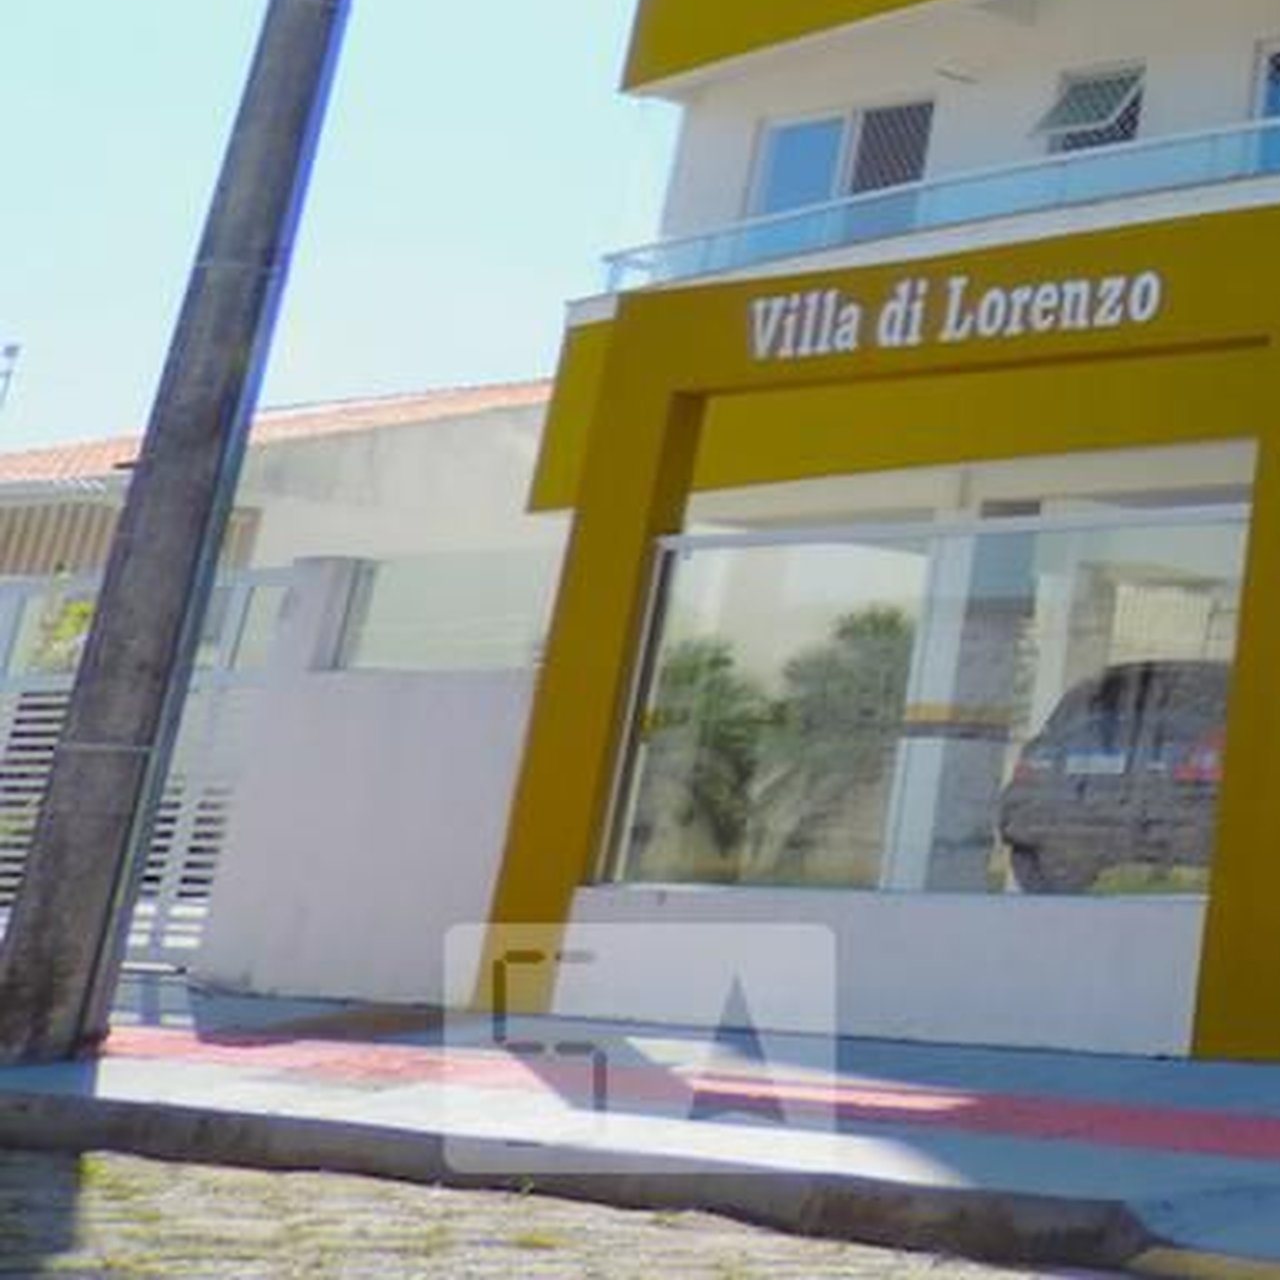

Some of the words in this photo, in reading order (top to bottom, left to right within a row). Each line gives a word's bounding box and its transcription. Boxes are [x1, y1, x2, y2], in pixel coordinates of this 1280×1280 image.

[750, 288, 861, 359] Villa
[877, 277, 929, 348] di
[938, 270, 1162, 342] Lorenzo
